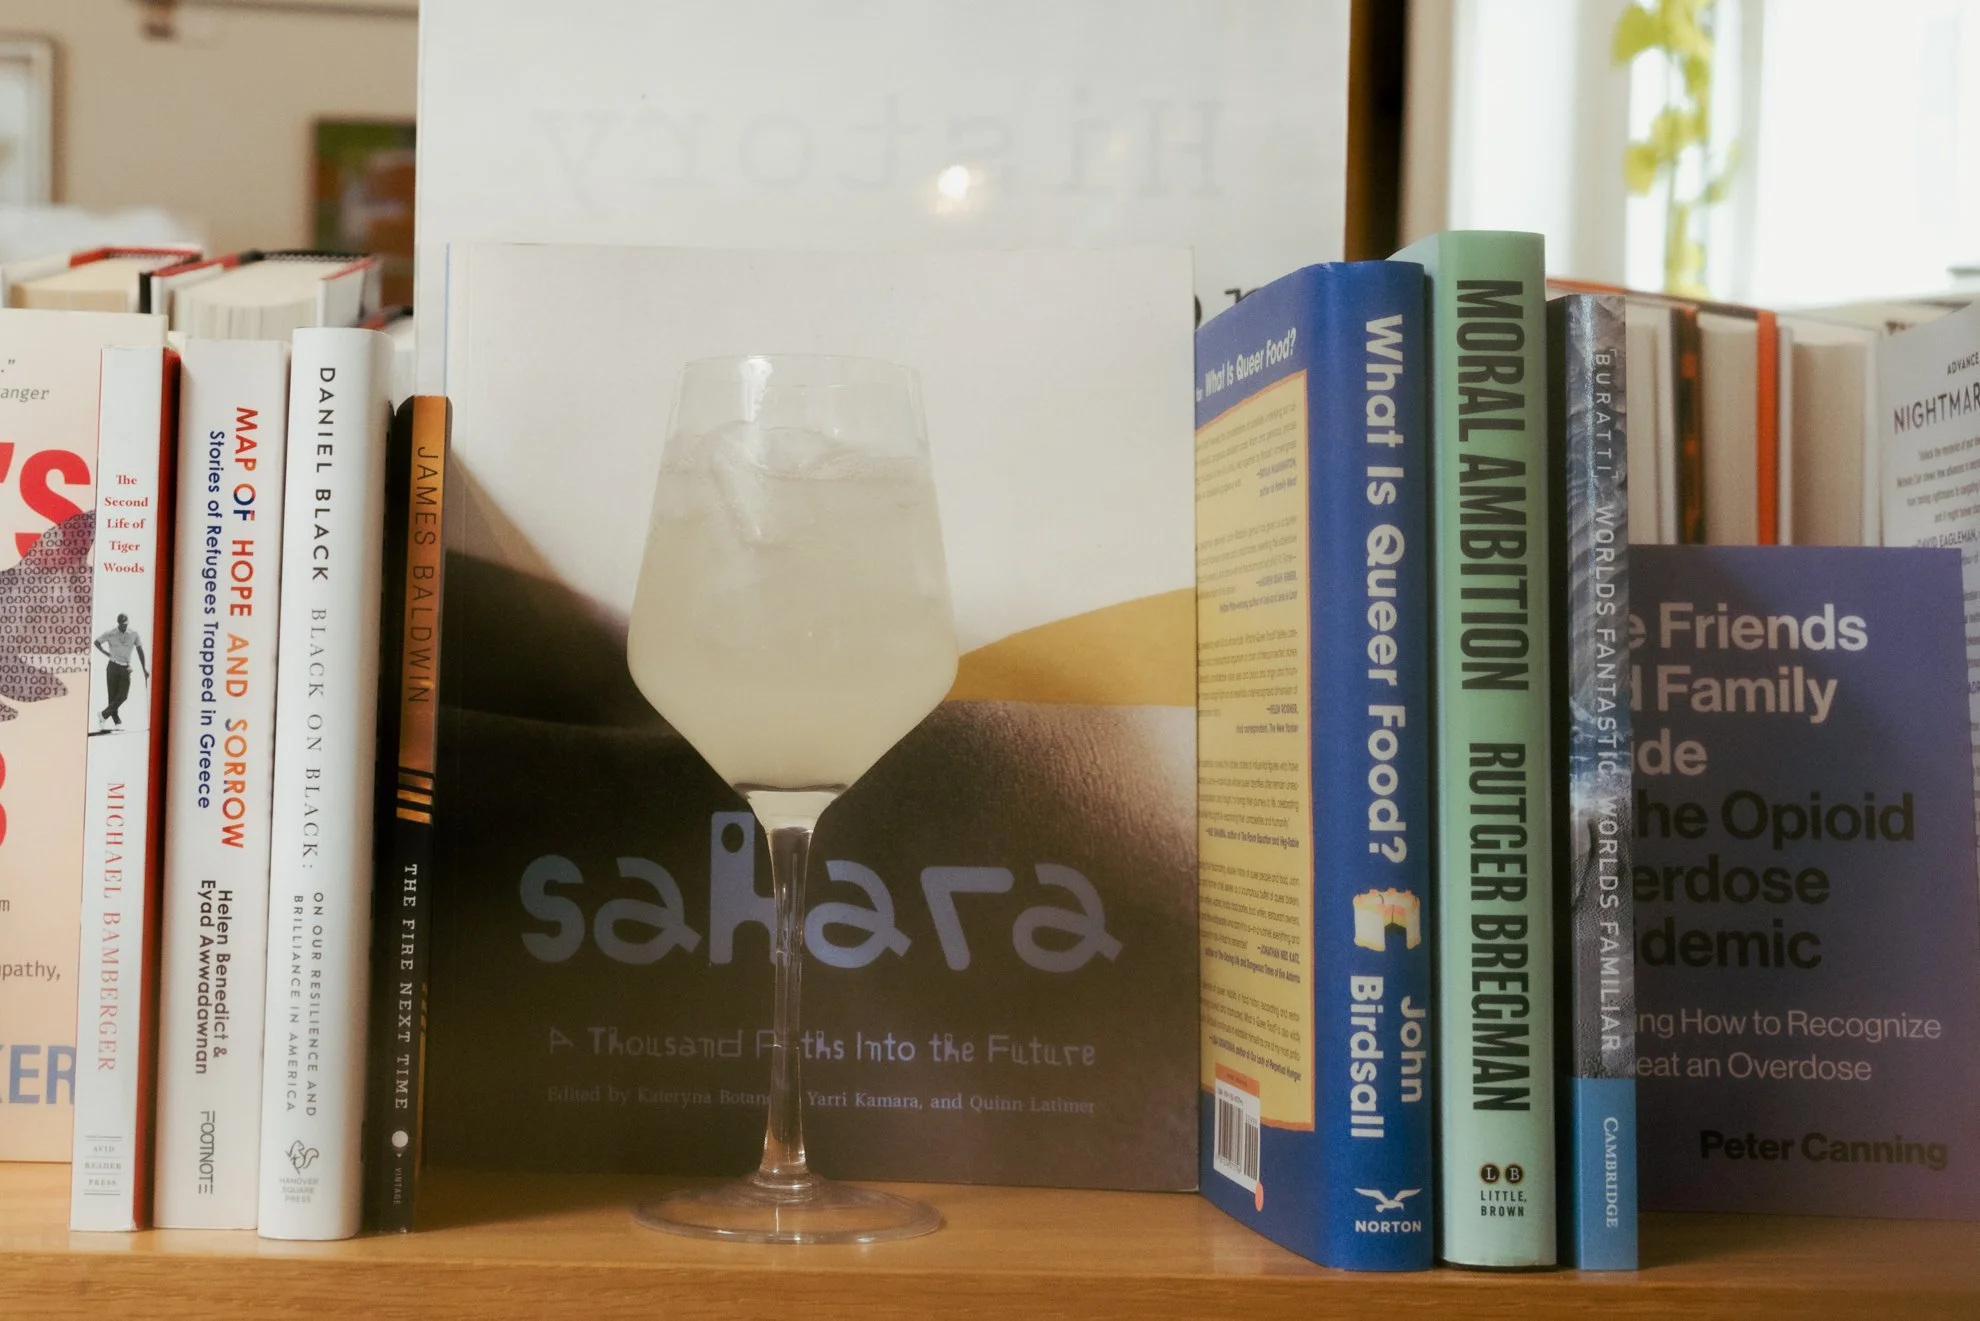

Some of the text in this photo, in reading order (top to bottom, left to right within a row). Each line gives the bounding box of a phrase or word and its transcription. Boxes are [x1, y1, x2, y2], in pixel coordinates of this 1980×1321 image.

[1205, 363, 1224, 398] What
[1226, 359, 1234, 388] Is
[1236, 347, 1264, 382] Queer
[1266, 326, 1297, 369] Food?
[1947, 352, 1979, 375] ADVANCE
[1595, 353, 1612, 471] BURATTI
[105, 496, 148, 508] Second
[116, 474, 137, 486] The
[311, 367, 336, 582] DANIEL BLACK
[1456, 279, 1530, 691] MORAL AMBITION
[107, 518, 146, 530] Life of
[109, 540, 141, 553] Tiger
[104, 562, 145, 574] Woods
[408, 446, 440, 703] JAMES BALDWIN
[1365, 314, 1407, 863] What Is Queer Food?
[1594, 505, 1616, 616] WORLDS
[197, 431, 225, 809] Stories of Refugees Trapped in Greece
[221, 407, 259, 849] MAP OF HOPE AND SORROW
[1658, 602, 1869, 652] Friends
[1656, 664, 1838, 724] Family
[302, 609, 327, 870] BLACK ON BLACK:
[1721, 789, 1915, 852] Opioid
[1598, 796, 1620, 909] WORLDS
[519, 811, 1124, 972] sahara
[97, 782, 126, 1072] MICHAEL BAMBERGER
[1468, 742, 1531, 1112] RUTGER BREGMAN
[0, 960, 61, 982] pathy,
[195, 880, 216, 1075] Eyad Awwadawnan
[213, 890, 233, 1058] Helen Benedict &
[394, 864, 418, 1110] THE FIRE NEXT TIME
[1600, 921, 1621, 1052] FAMILIAR
[286, 895, 304, 1112] BRILLIANCE IN AMERICA
[305, 892, 324, 1118] ON OUR RESILIENCE AND
[1681, 1009, 1748, 1036] How
[1753, 1010, 1781, 1036] to
[1788, 1010, 1942, 1043] Recognize
[0, 1044, 76, 1105] ER
[548, 1026, 1096, 1067] A Thousand Pths Into the Future
[1350, 974, 1385, 1139] Birdsall
[1400, 995, 1427, 1104] John
[1687, 1056, 1721, 1079] an
[1728, 1052, 1872, 1082] Overdose
[807, 1090, 848, 1109] Yarri
[856, 1092, 923, 1112] Kamara,
[931, 1092, 963, 1110] and
[969, 1093, 1023, 1115] Quinn
[1031, 1095, 1096, 1114] Latimer
[279, 1177, 320, 1186] HANOVER
[1485, 1166, 1521, 1181] L B
[1701, 1129, 1949, 1173] Peter Canning
[88, 1178, 117, 1187] PRESS
[281, 1186, 315, 1194] SQUARE
[284, 1195, 312, 1204] PRESS
[1480, 1189, 1527, 1203] LITTLE,
[1481, 1205, 1525, 1218] BROWN
[1354, 1219, 1422, 1234] NORTON
